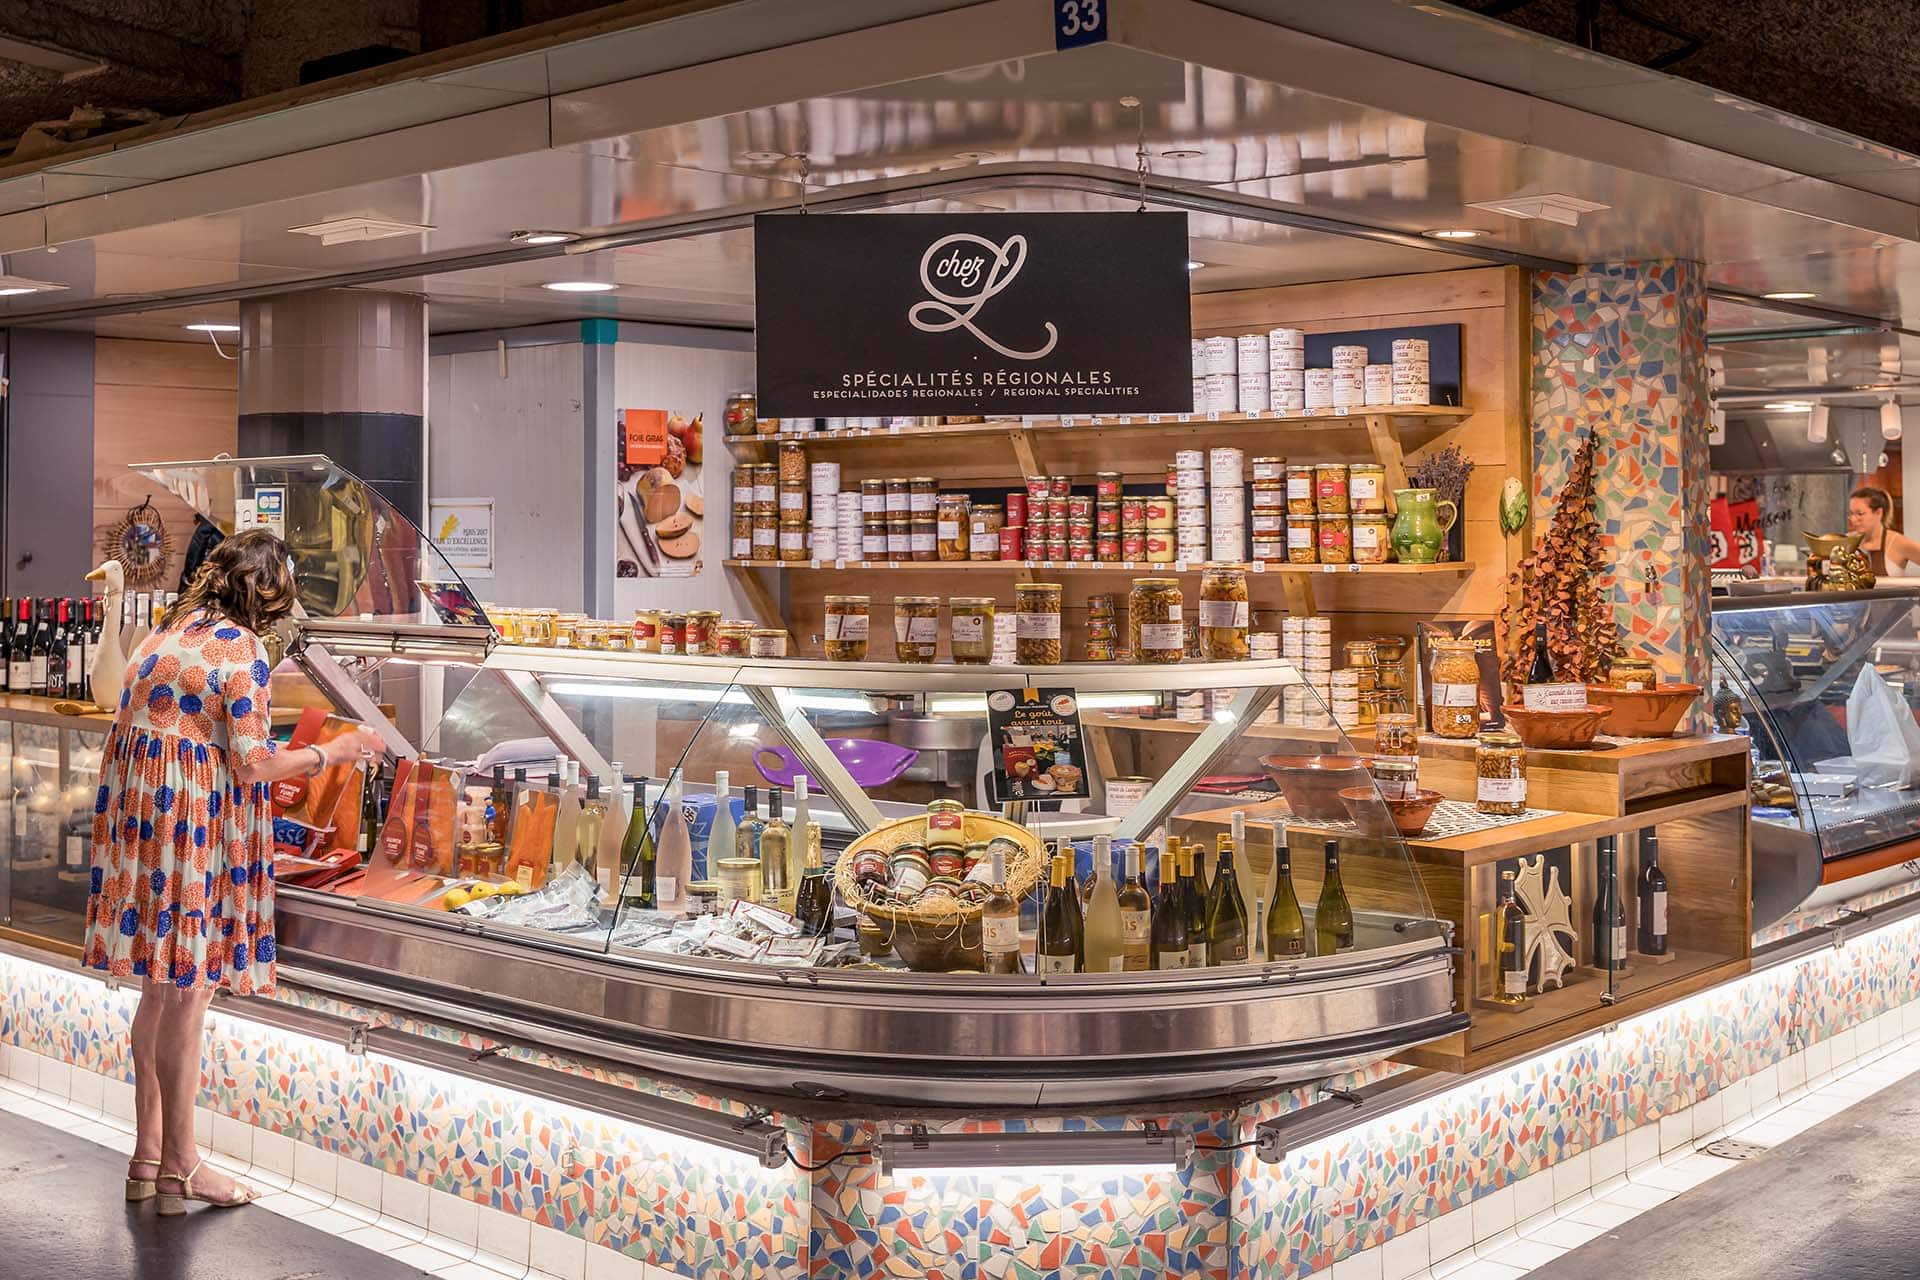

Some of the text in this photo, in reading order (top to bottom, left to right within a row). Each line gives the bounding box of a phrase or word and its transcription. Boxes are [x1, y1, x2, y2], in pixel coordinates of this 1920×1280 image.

[1062, 0, 1100, 36] 33
[937, 250, 985, 288] chez
[842, 369, 1112, 387] SPÉCIALITÉS RÉGIONALES
[813, 389, 908, 399] ESPECIALIDADES
[912, 388, 983, 398] REGIONALES
[1003, 387, 1061, 397] REGIONAL
[1064, 386, 1140, 396] SPECIALITIES
[629, 433, 664, 442] FOIE GRAS
[1014, 710, 1027, 719] Le
[1010, 718, 1065, 727] avant tout
[276, 827, 306, 845] sse
